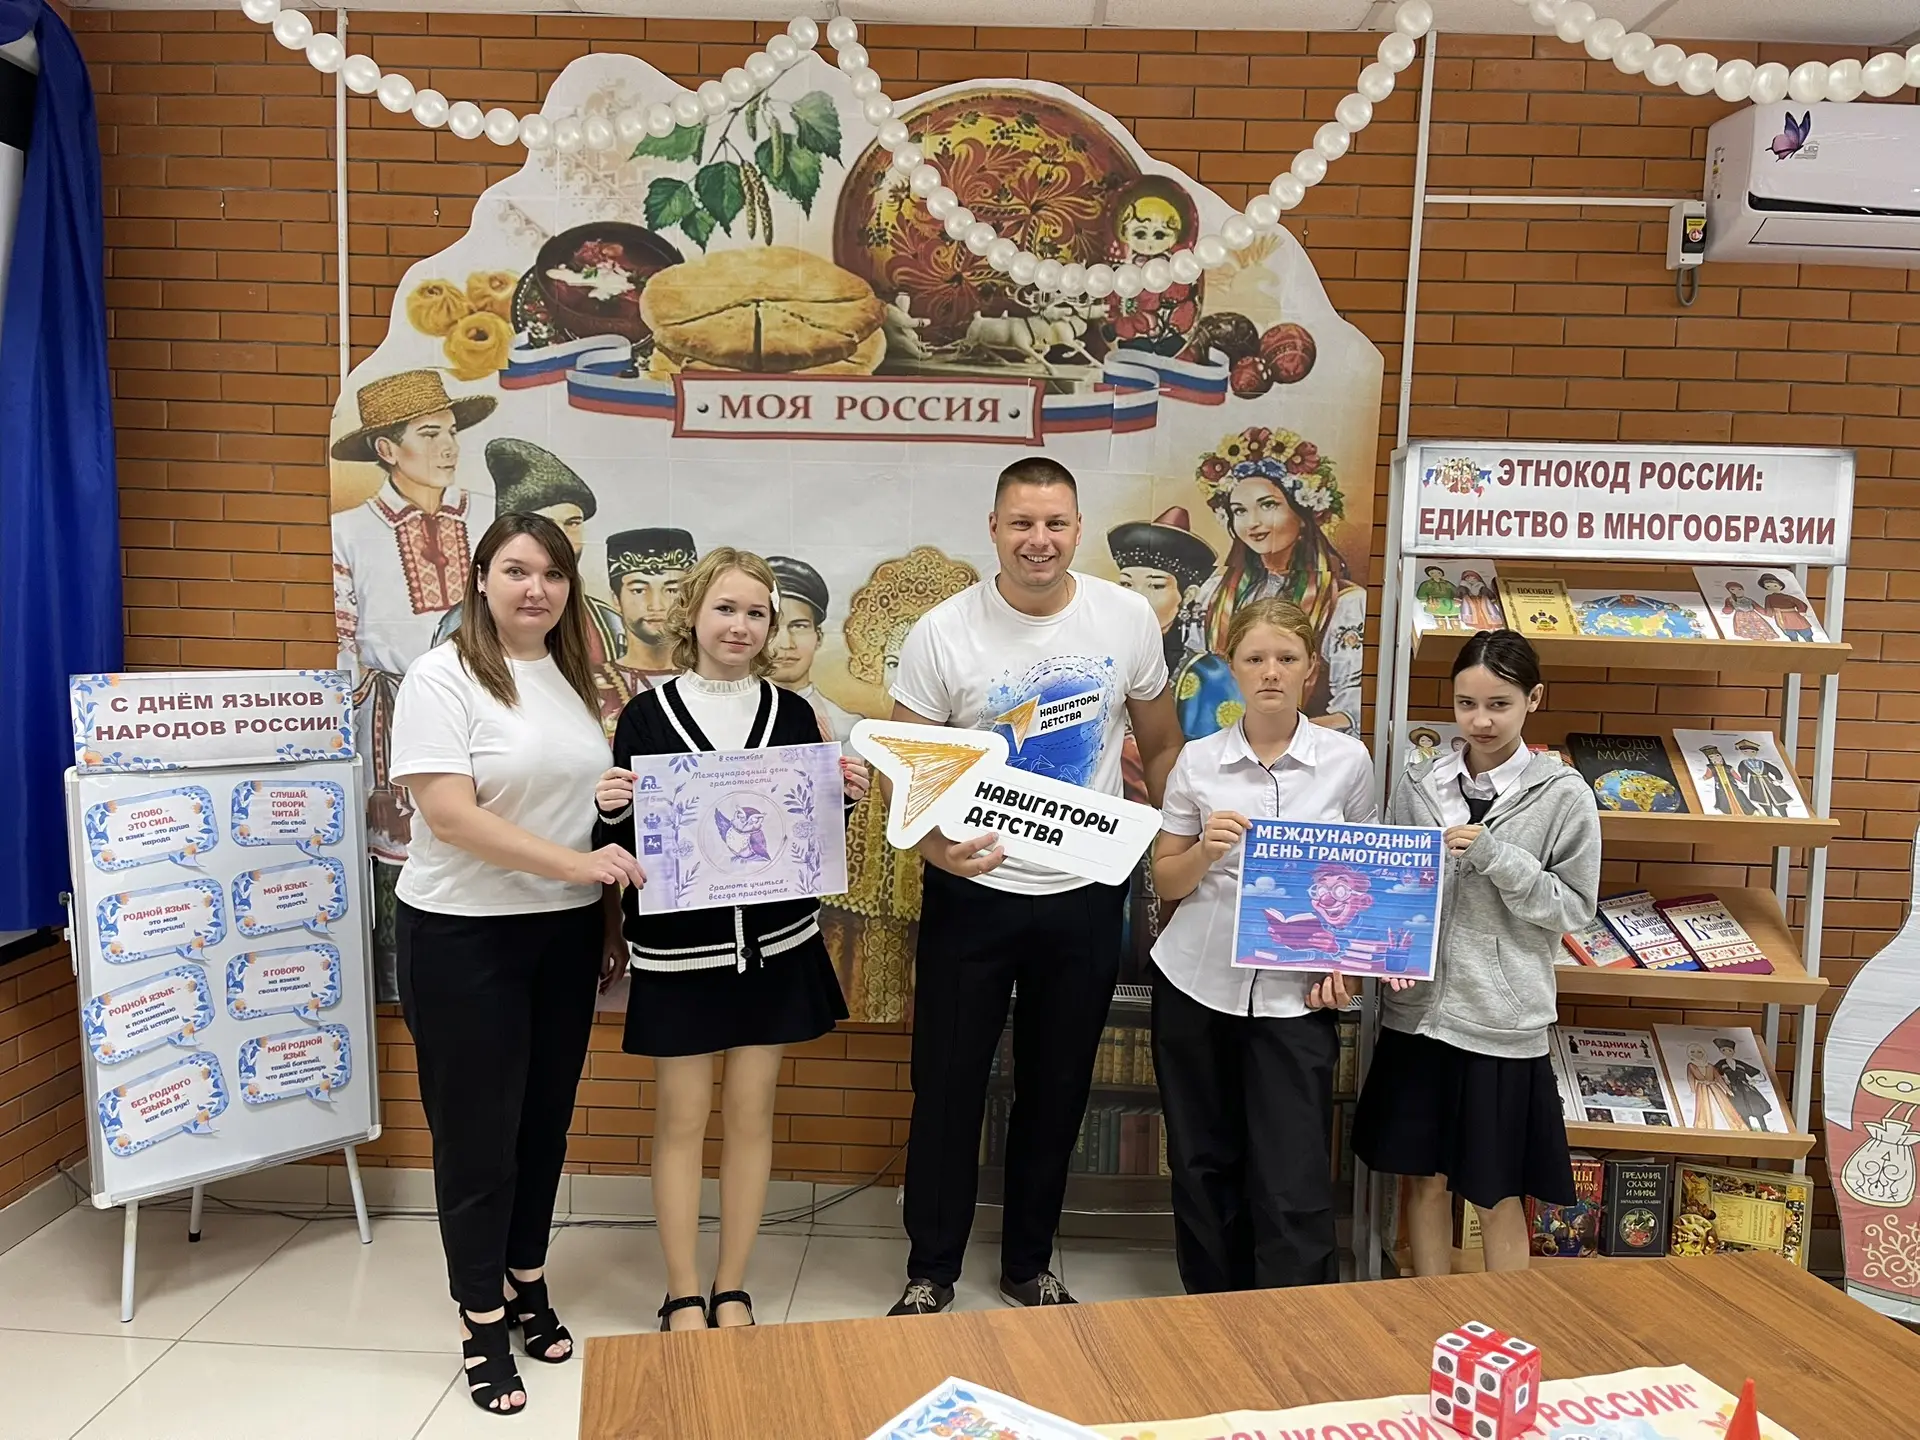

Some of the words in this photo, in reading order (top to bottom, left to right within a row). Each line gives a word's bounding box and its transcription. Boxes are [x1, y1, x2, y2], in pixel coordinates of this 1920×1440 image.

[719, 394, 812, 420] МОЯ
[835, 396, 1000, 423] РОССИЯ
[1496, 458, 1630, 494] ЭТНОКОД
[1639, 461, 1764, 492] РОССИИ:
[1419, 508, 1569, 541] ЕДИНСТВО
[1577, 511, 1595, 539] В
[1604, 512, 1836, 546] МНОГООБРАЗИИ
[110, 696, 129, 713] С
[137, 692, 214, 716] ДНЁМ
[222, 691, 325, 709] ЯЗЫКОВ
[1039, 693, 1101, 718] НАВИГАТОРЫ
[95, 721, 227, 741] НАРОДОВ
[235, 716, 338, 734] РОССИИ!
[1040, 710, 1083, 731] ДЕТСТВА
[1581, 736, 1657, 750] НАРОДЫ
[725, 753, 764, 762] сентября
[1597, 750, 1649, 762] МИРА
[691, 767, 768, 780] Международный
[769, 767, 789, 775] день
[709, 777, 773, 789] грамотности
[131, 808, 163, 820] СЛОВО
[272, 809, 300, 817] ЧИТАЙ
[974, 781, 1120, 836] НАВИГАТОРЫ
[125, 833, 145, 841] язык
[169, 823, 190, 834] душа
[128, 821, 147, 831] ЭТО
[963, 806, 1064, 847] ДЕТСТВА
[142, 836, 171, 847] народа
[1256, 824, 1432, 849] МЕЖДУНАРОДНЫЙ
[1252, 842, 1304, 859] ДЕНЬ
[1308, 847, 1432, 867] ГРАМОТНОСТИ
[263, 885, 283, 895] МОЙ
[284, 881, 308, 892] ЯЗЫК
[749, 878, 785, 889] учиться
[123, 906, 163, 922] РОДНОЙ
[164, 903, 191, 914] ЯЗЫК
[143, 922, 186, 936] суперсила!
[270, 965, 306, 977] ГОВОРЮ
[108, 995, 148, 1017] РОДНОЙ
[148, 987, 176, 1002] ЯЗЫК
[131, 1009, 144, 1018] это
[145, 1002, 166, 1012] ключ
[132, 1007, 176, 1027] пониманию
[127, 1026, 149, 1038] своей
[150, 1014, 180, 1029] истории
[267, 1042, 287, 1053] МОЙ
[288, 1036, 323, 1050] РОДНОЙ
[1578, 1039, 1639, 1050] ПРАЗДНИКИ
[283, 1050, 307, 1061] ЯЗЫК
[1590, 1050, 1604, 1058] НА
[1606, 1050, 1632, 1059] РУСИ
[131, 1097, 148, 1109] БЕЗ
[148, 1078, 192, 1101] РОДНОГО
[140, 1098, 173, 1116] ЯЗЫКА
[173, 1093, 180, 1101] Я
[145, 1114, 160, 1123] как
[160, 1107, 173, 1117] без
[1626, 1180, 1656, 1188] СКАЗКИ
[1633, 1189, 1657, 1197] МИФЫ
